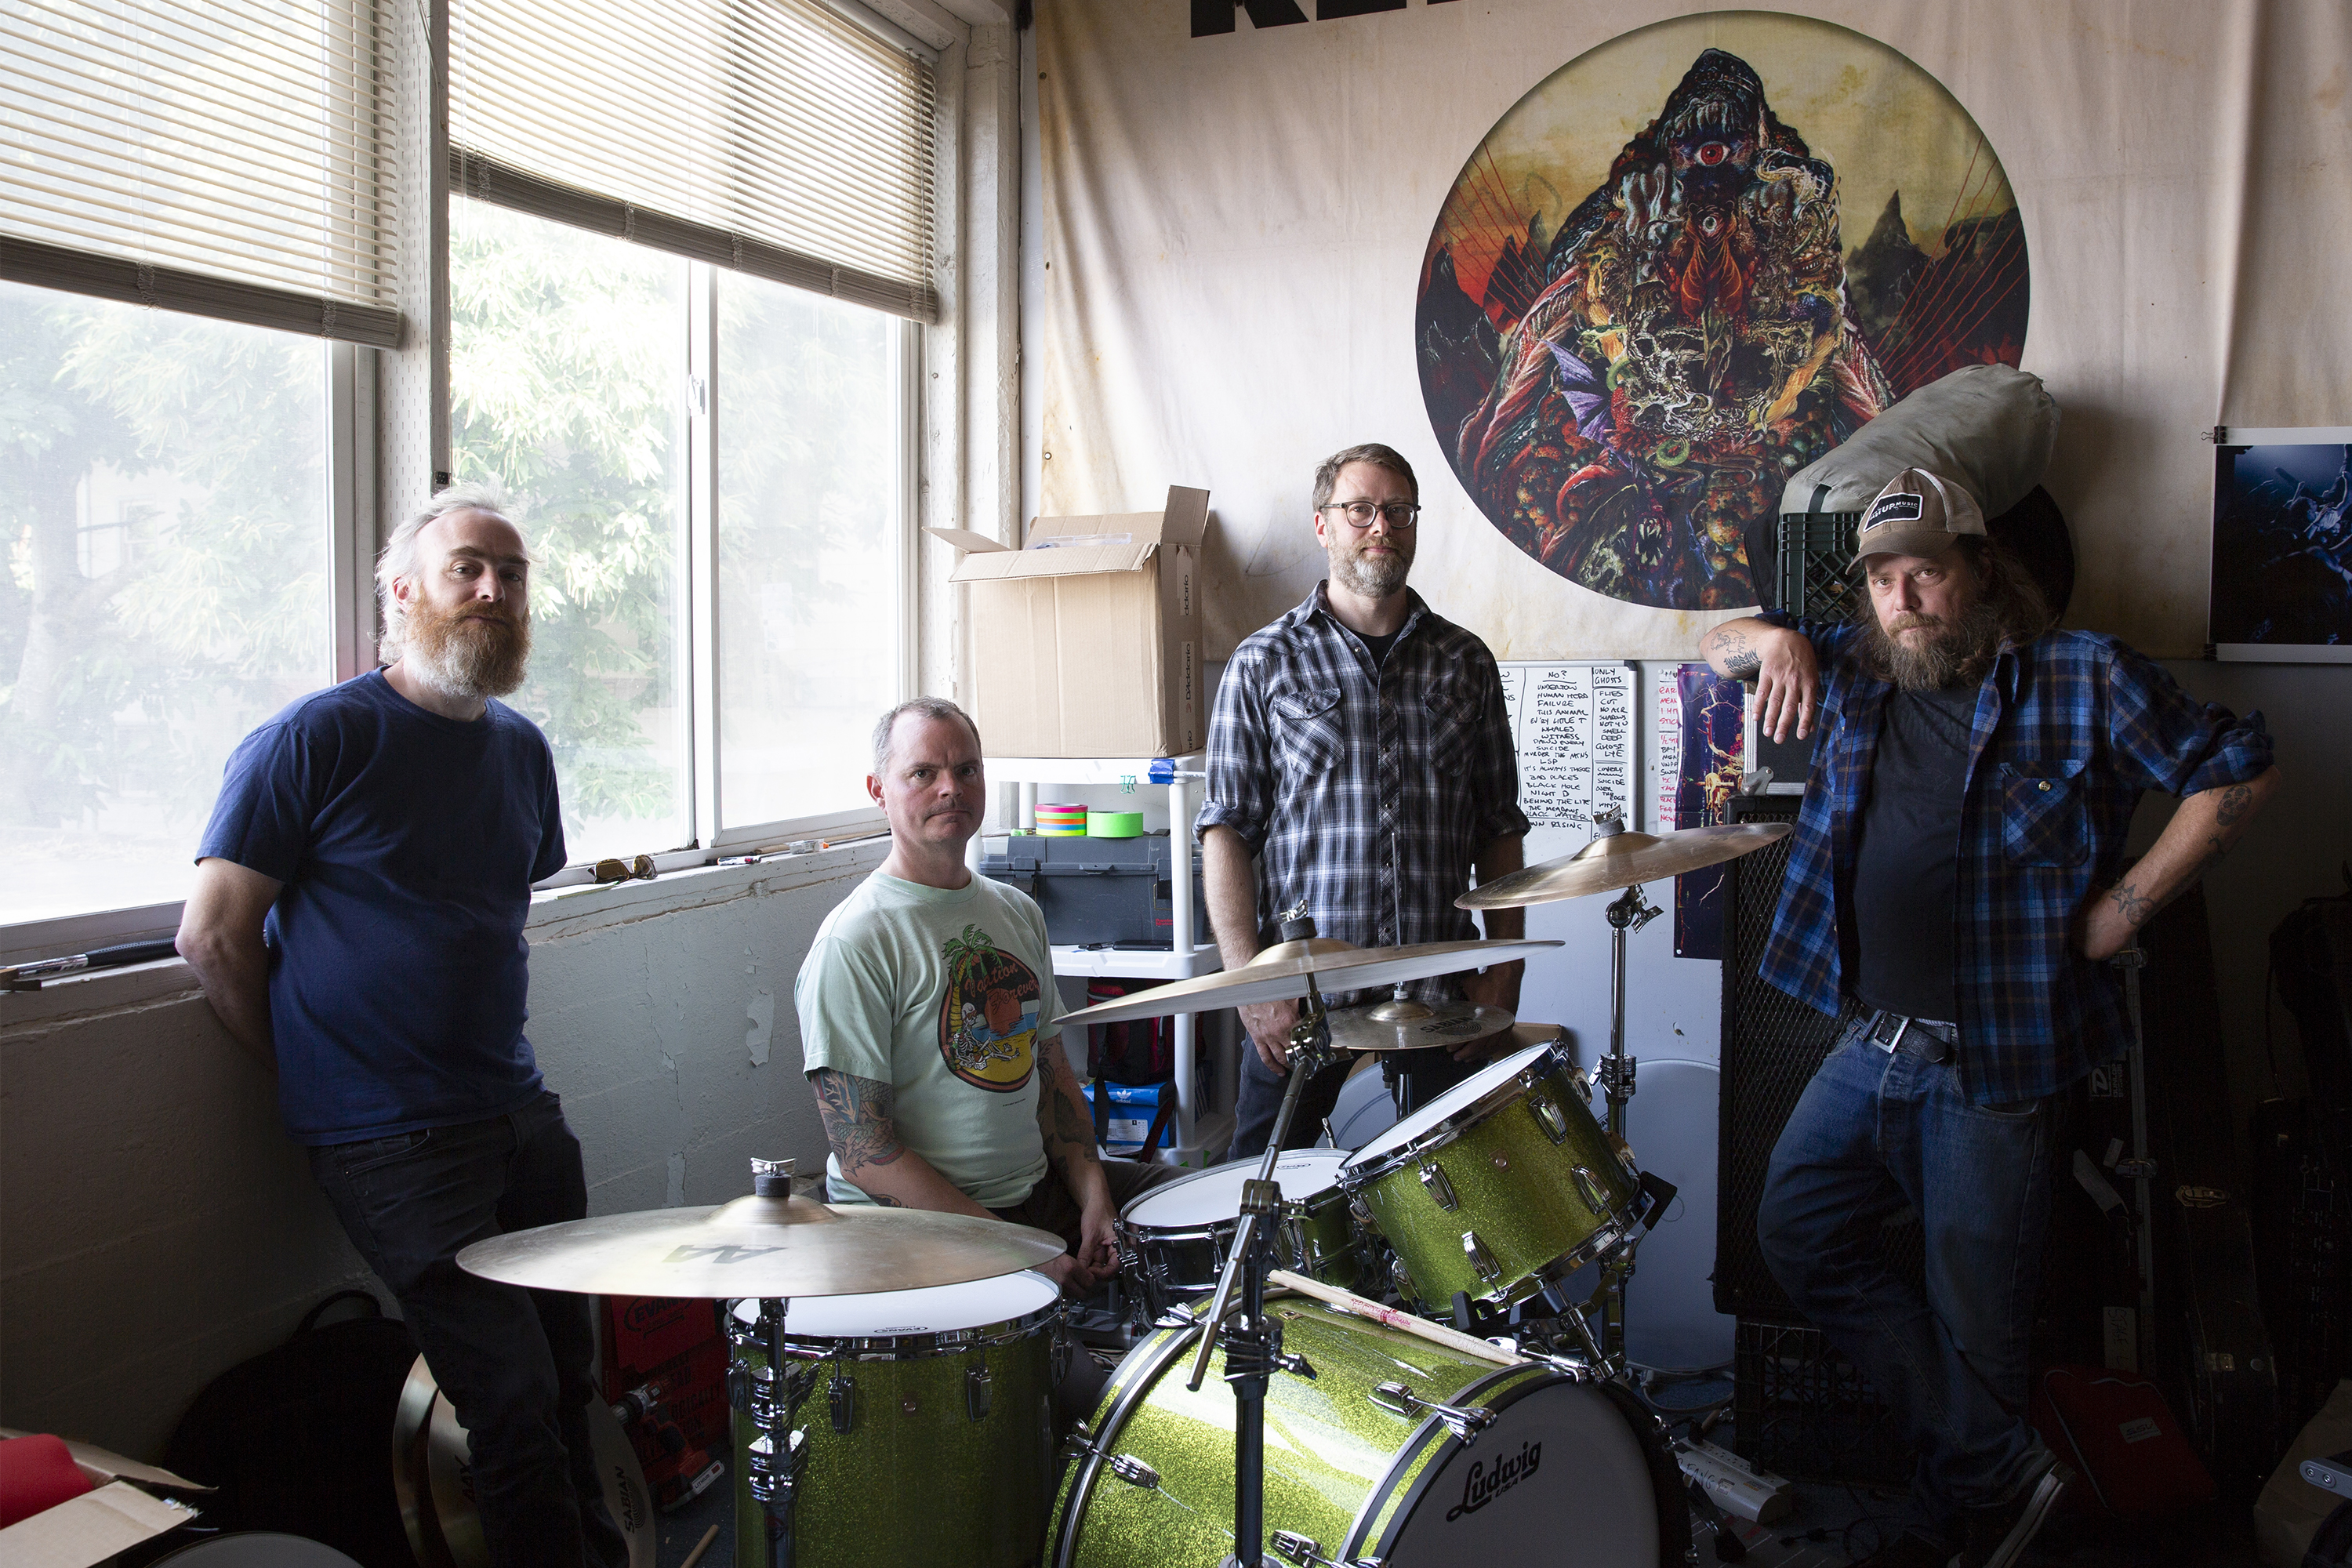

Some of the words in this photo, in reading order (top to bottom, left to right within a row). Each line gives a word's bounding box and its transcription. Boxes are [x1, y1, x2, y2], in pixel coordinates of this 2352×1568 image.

[1882, 503, 1895, 512] UP
[1546, 806, 1579, 815] MEADOWS
[1555, 811, 1588, 821] WATER
[1551, 821, 1582, 830] RISING
[964, 962, 1018, 998] Vaation
[1420, 1016, 1474, 1033] SABIAN
[1446, 1441, 1541, 1522] Ludwig
[1495, 1476, 1519, 1497] USA
[615, 1465, 635, 1534] SABIAN
